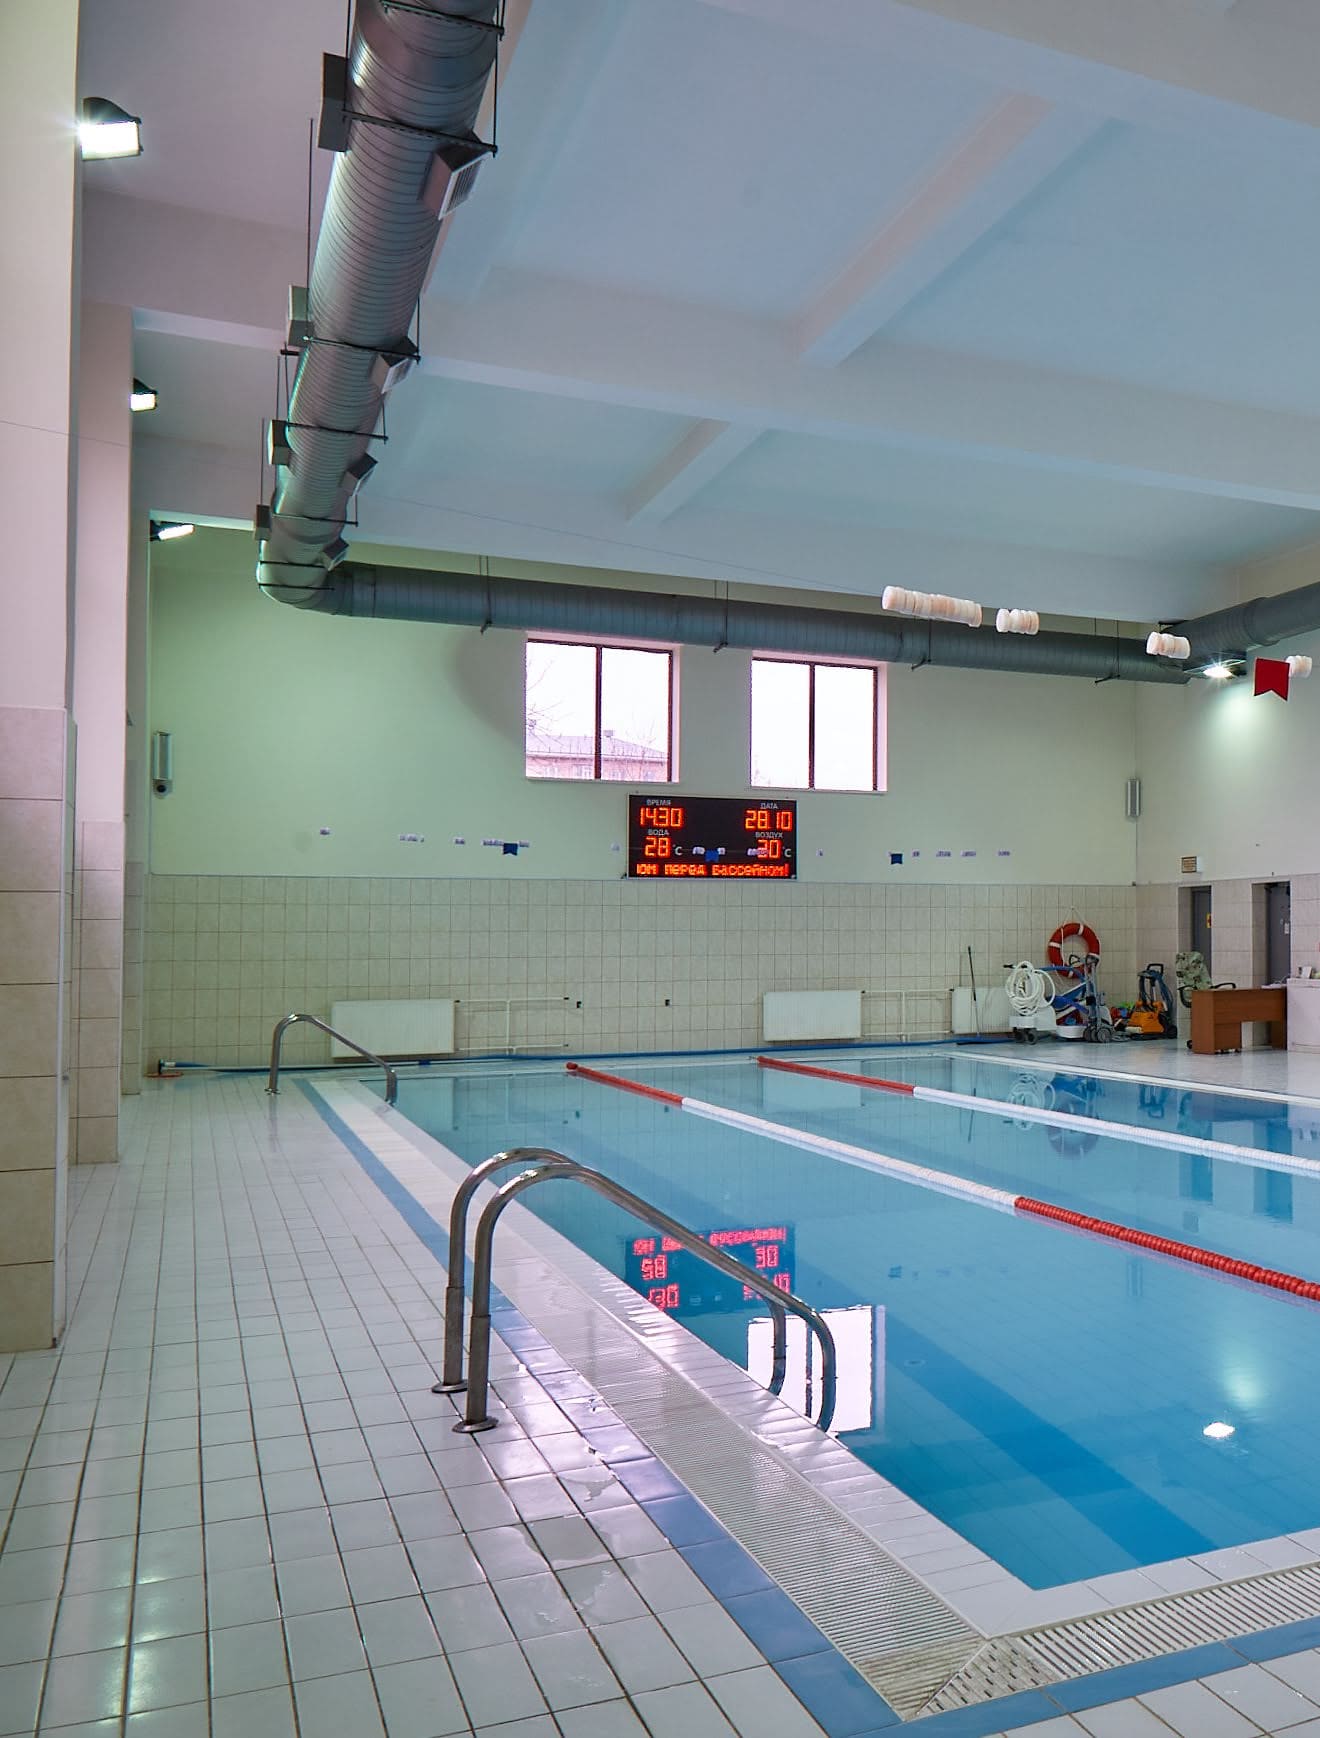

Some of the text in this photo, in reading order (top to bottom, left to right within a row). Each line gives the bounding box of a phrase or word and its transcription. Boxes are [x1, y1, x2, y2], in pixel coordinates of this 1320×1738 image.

[647, 829, 670, 837] ВОДА
[755, 831, 784, 840] ВОЗДУХ
[645, 836, 671, 857] 28
